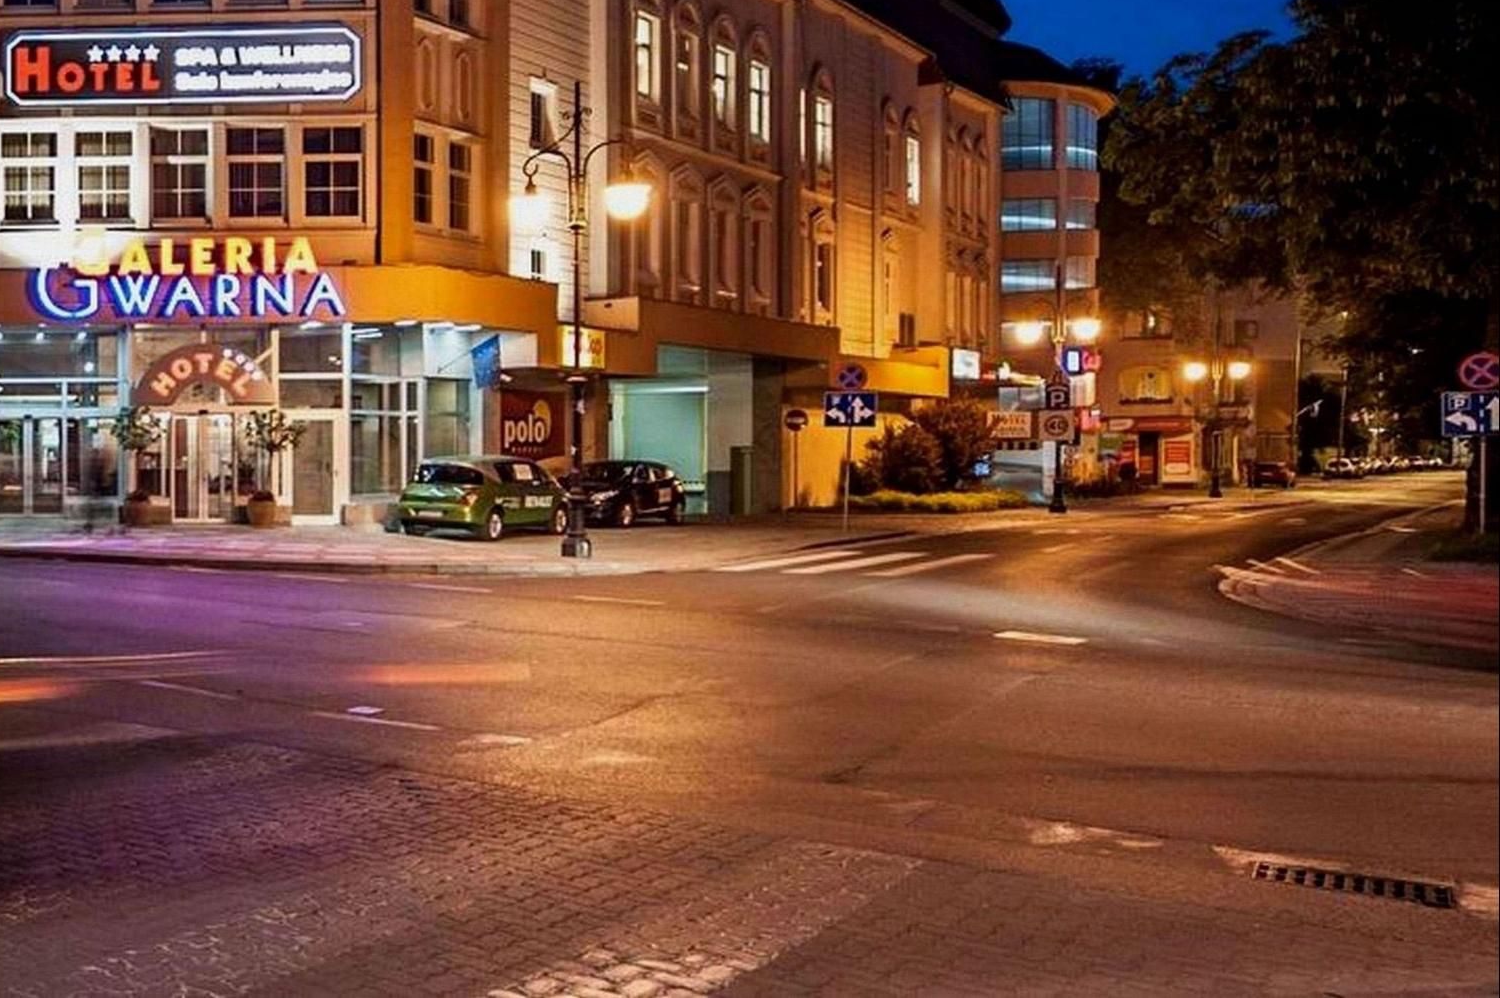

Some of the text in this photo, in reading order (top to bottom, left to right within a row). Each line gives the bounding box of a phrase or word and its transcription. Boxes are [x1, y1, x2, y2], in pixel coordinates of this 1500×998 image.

[15, 46, 161, 93] HOTEL
[73, 228, 319, 275] GALERIA
[30, 264, 347, 320] GWARNA
[150, 353, 252, 397] HOTEL
[504, 413, 546, 449] polo
